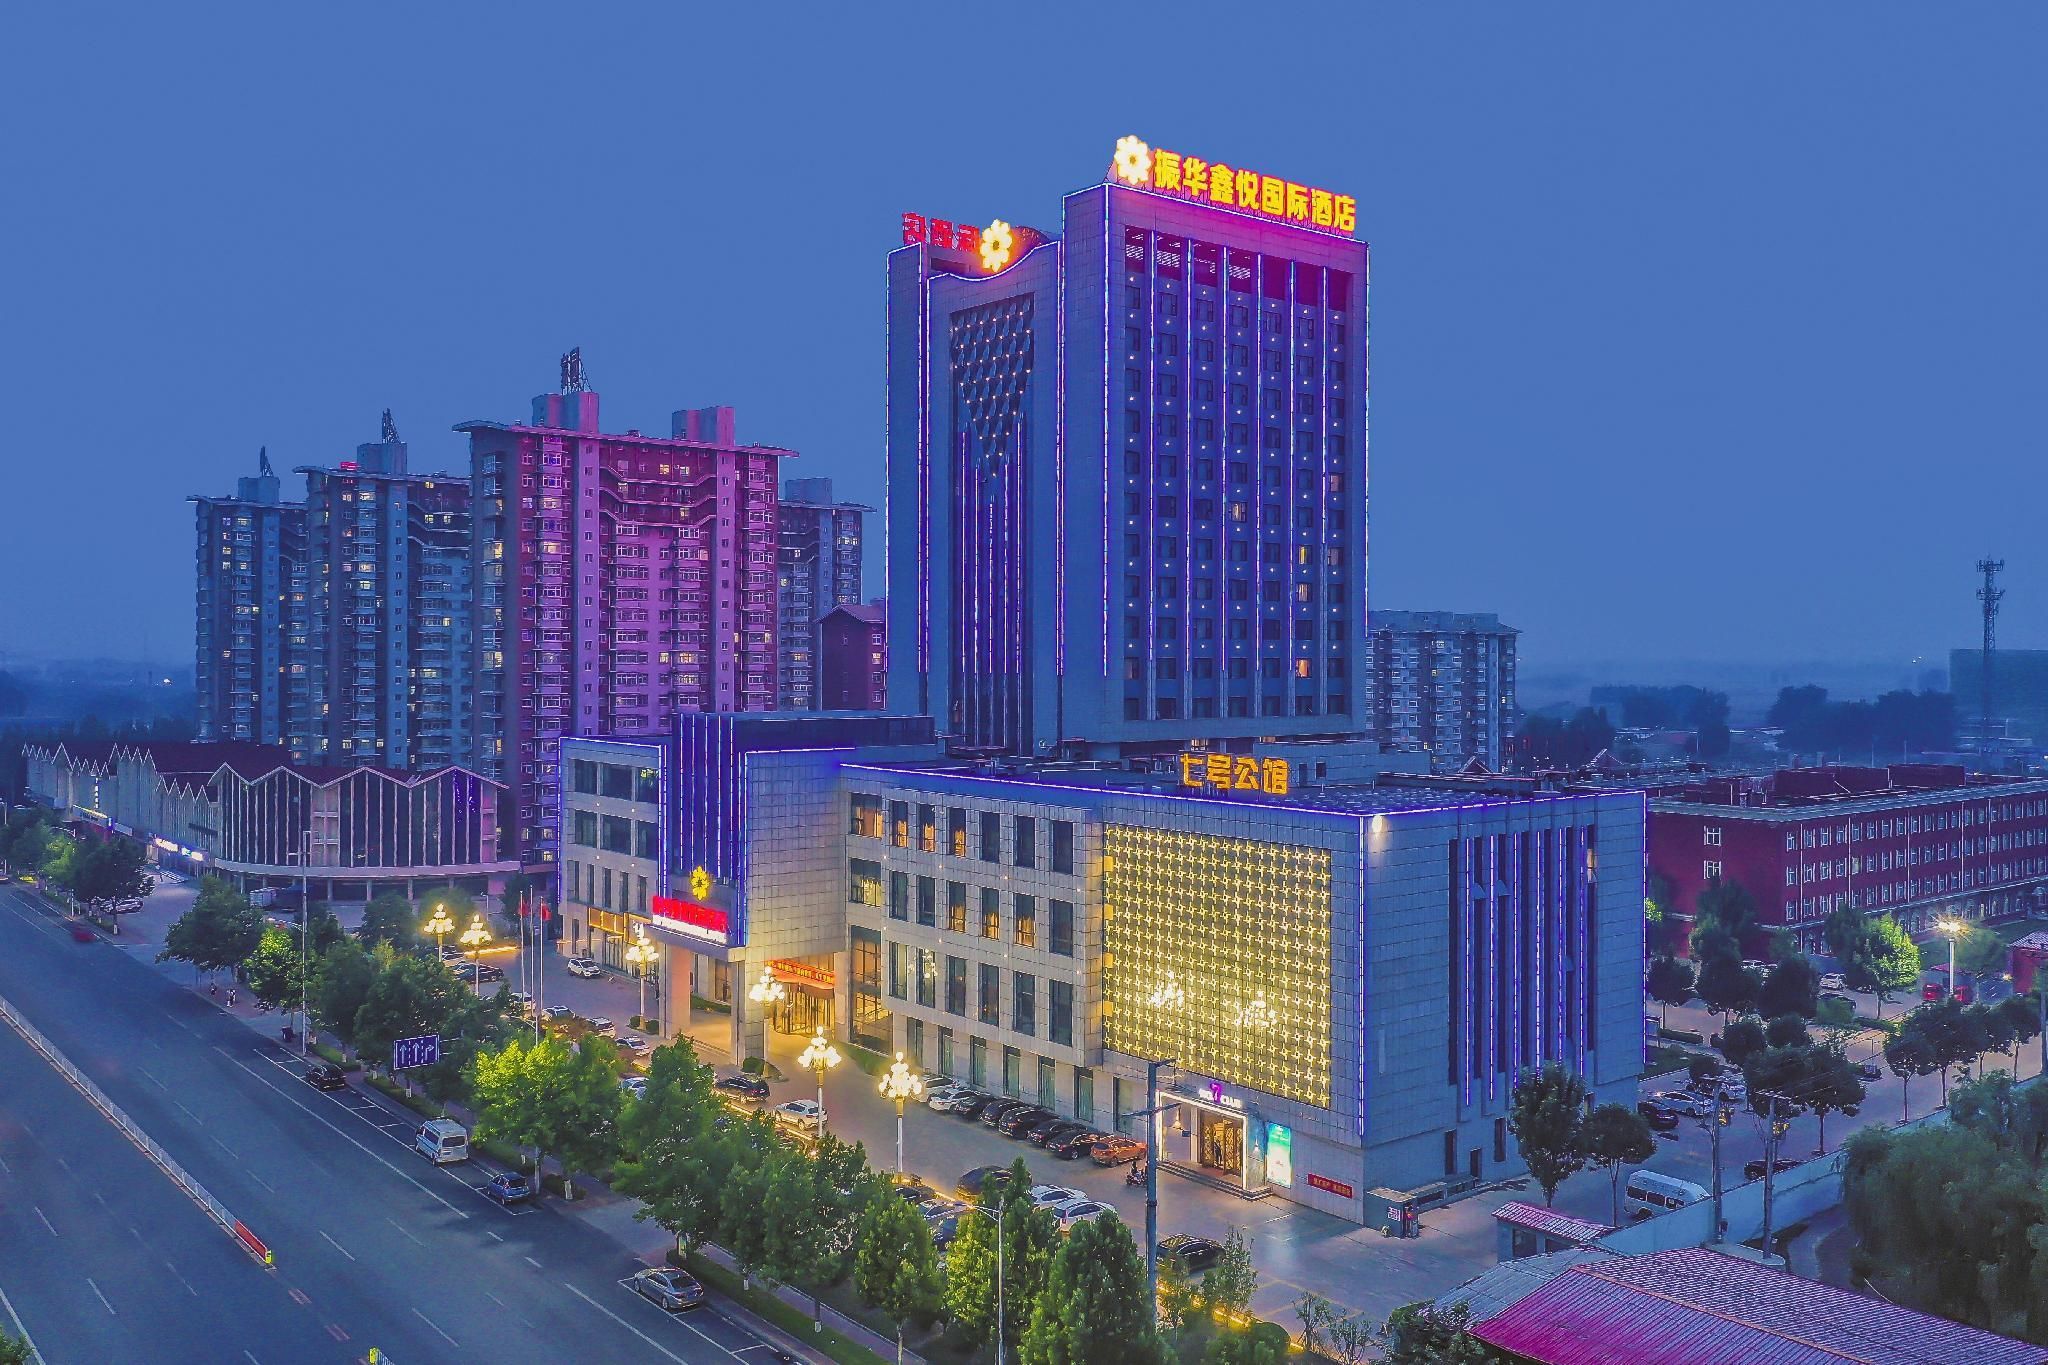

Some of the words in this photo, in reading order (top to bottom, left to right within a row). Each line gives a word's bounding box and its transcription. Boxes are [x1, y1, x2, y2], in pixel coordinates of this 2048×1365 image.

[1154, 149, 1356, 232] 振华鑫悦国际酒店
[1180, 753, 1288, 794] 七号公馆
